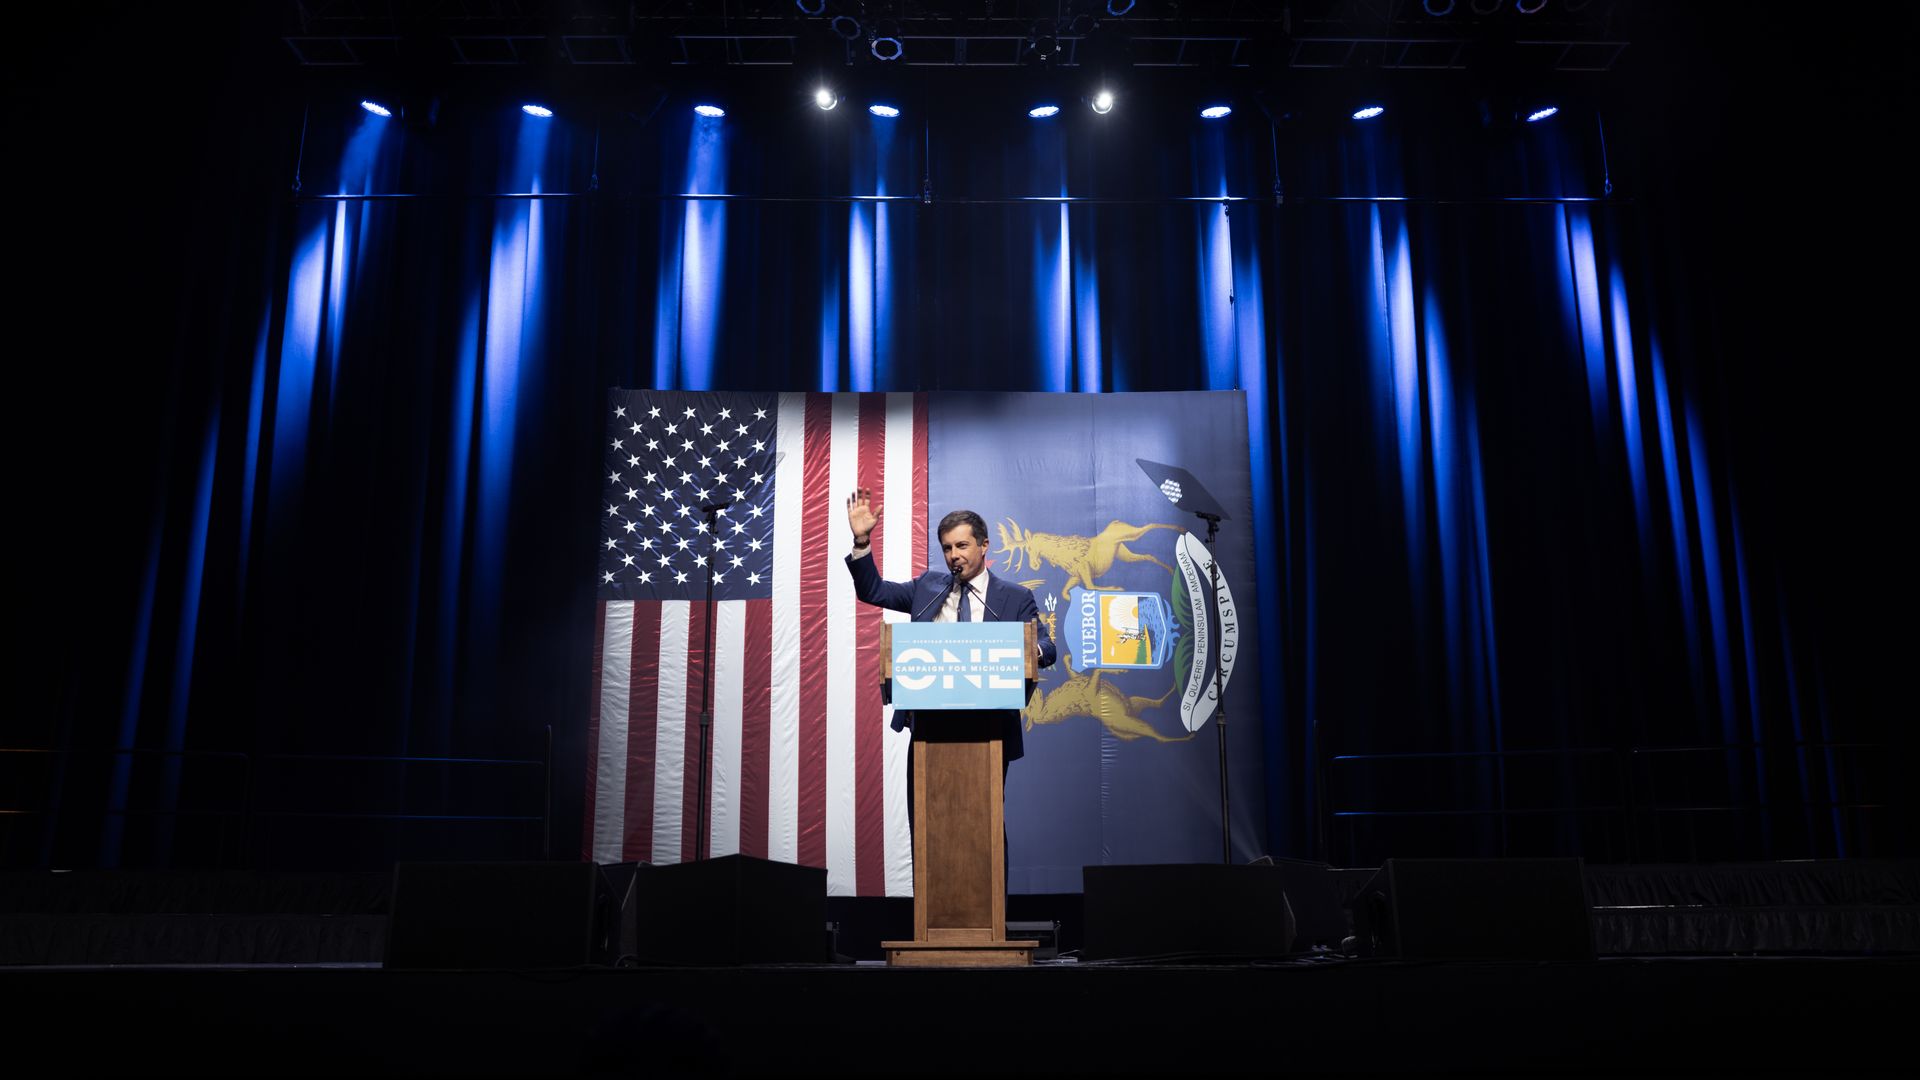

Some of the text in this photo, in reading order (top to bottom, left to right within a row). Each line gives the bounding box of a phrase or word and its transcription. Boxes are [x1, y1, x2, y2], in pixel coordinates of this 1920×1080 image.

[1081, 590, 1097, 668] TUEBOR
[1183, 702, 1191, 712] SI
[1195, 598, 1205, 654] PENINSULAM
[895, 648, 1021, 690] ONE
[895, 665, 1019, 673] CAMPAIGN FOR MICHIGAN
